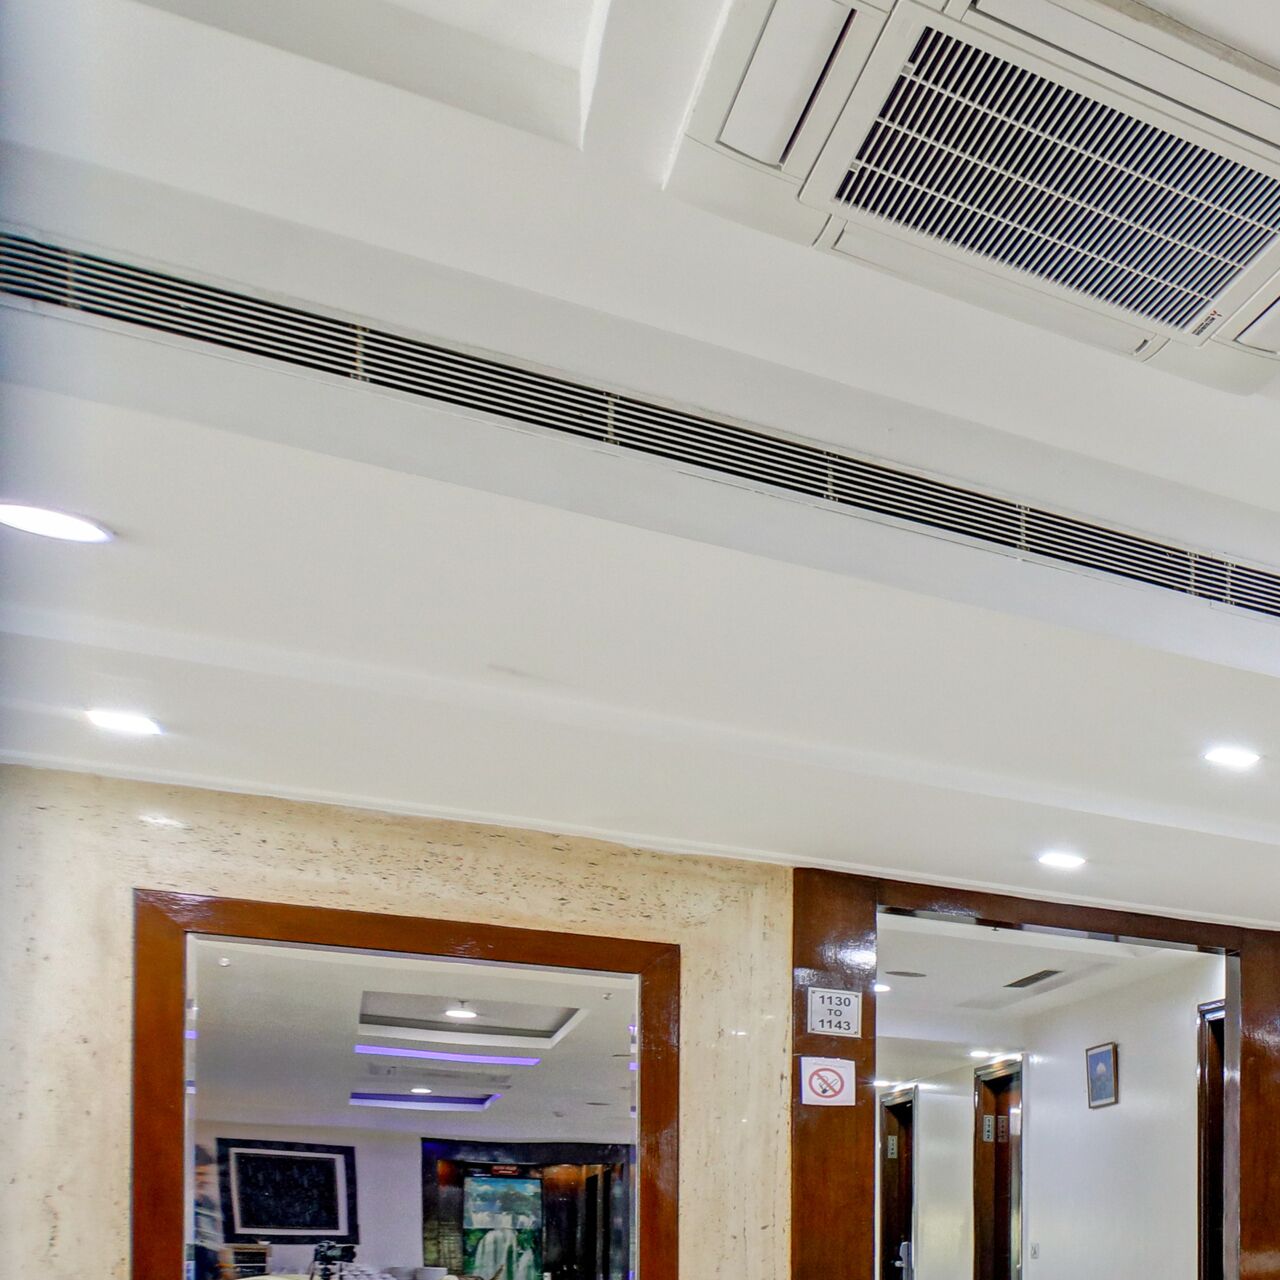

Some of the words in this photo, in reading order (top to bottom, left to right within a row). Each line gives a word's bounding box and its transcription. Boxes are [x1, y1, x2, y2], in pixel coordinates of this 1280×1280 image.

[819, 995, 851, 1007] 1130
[827, 1008, 843, 1017] TO
[818, 1019, 851, 1031] 1143
